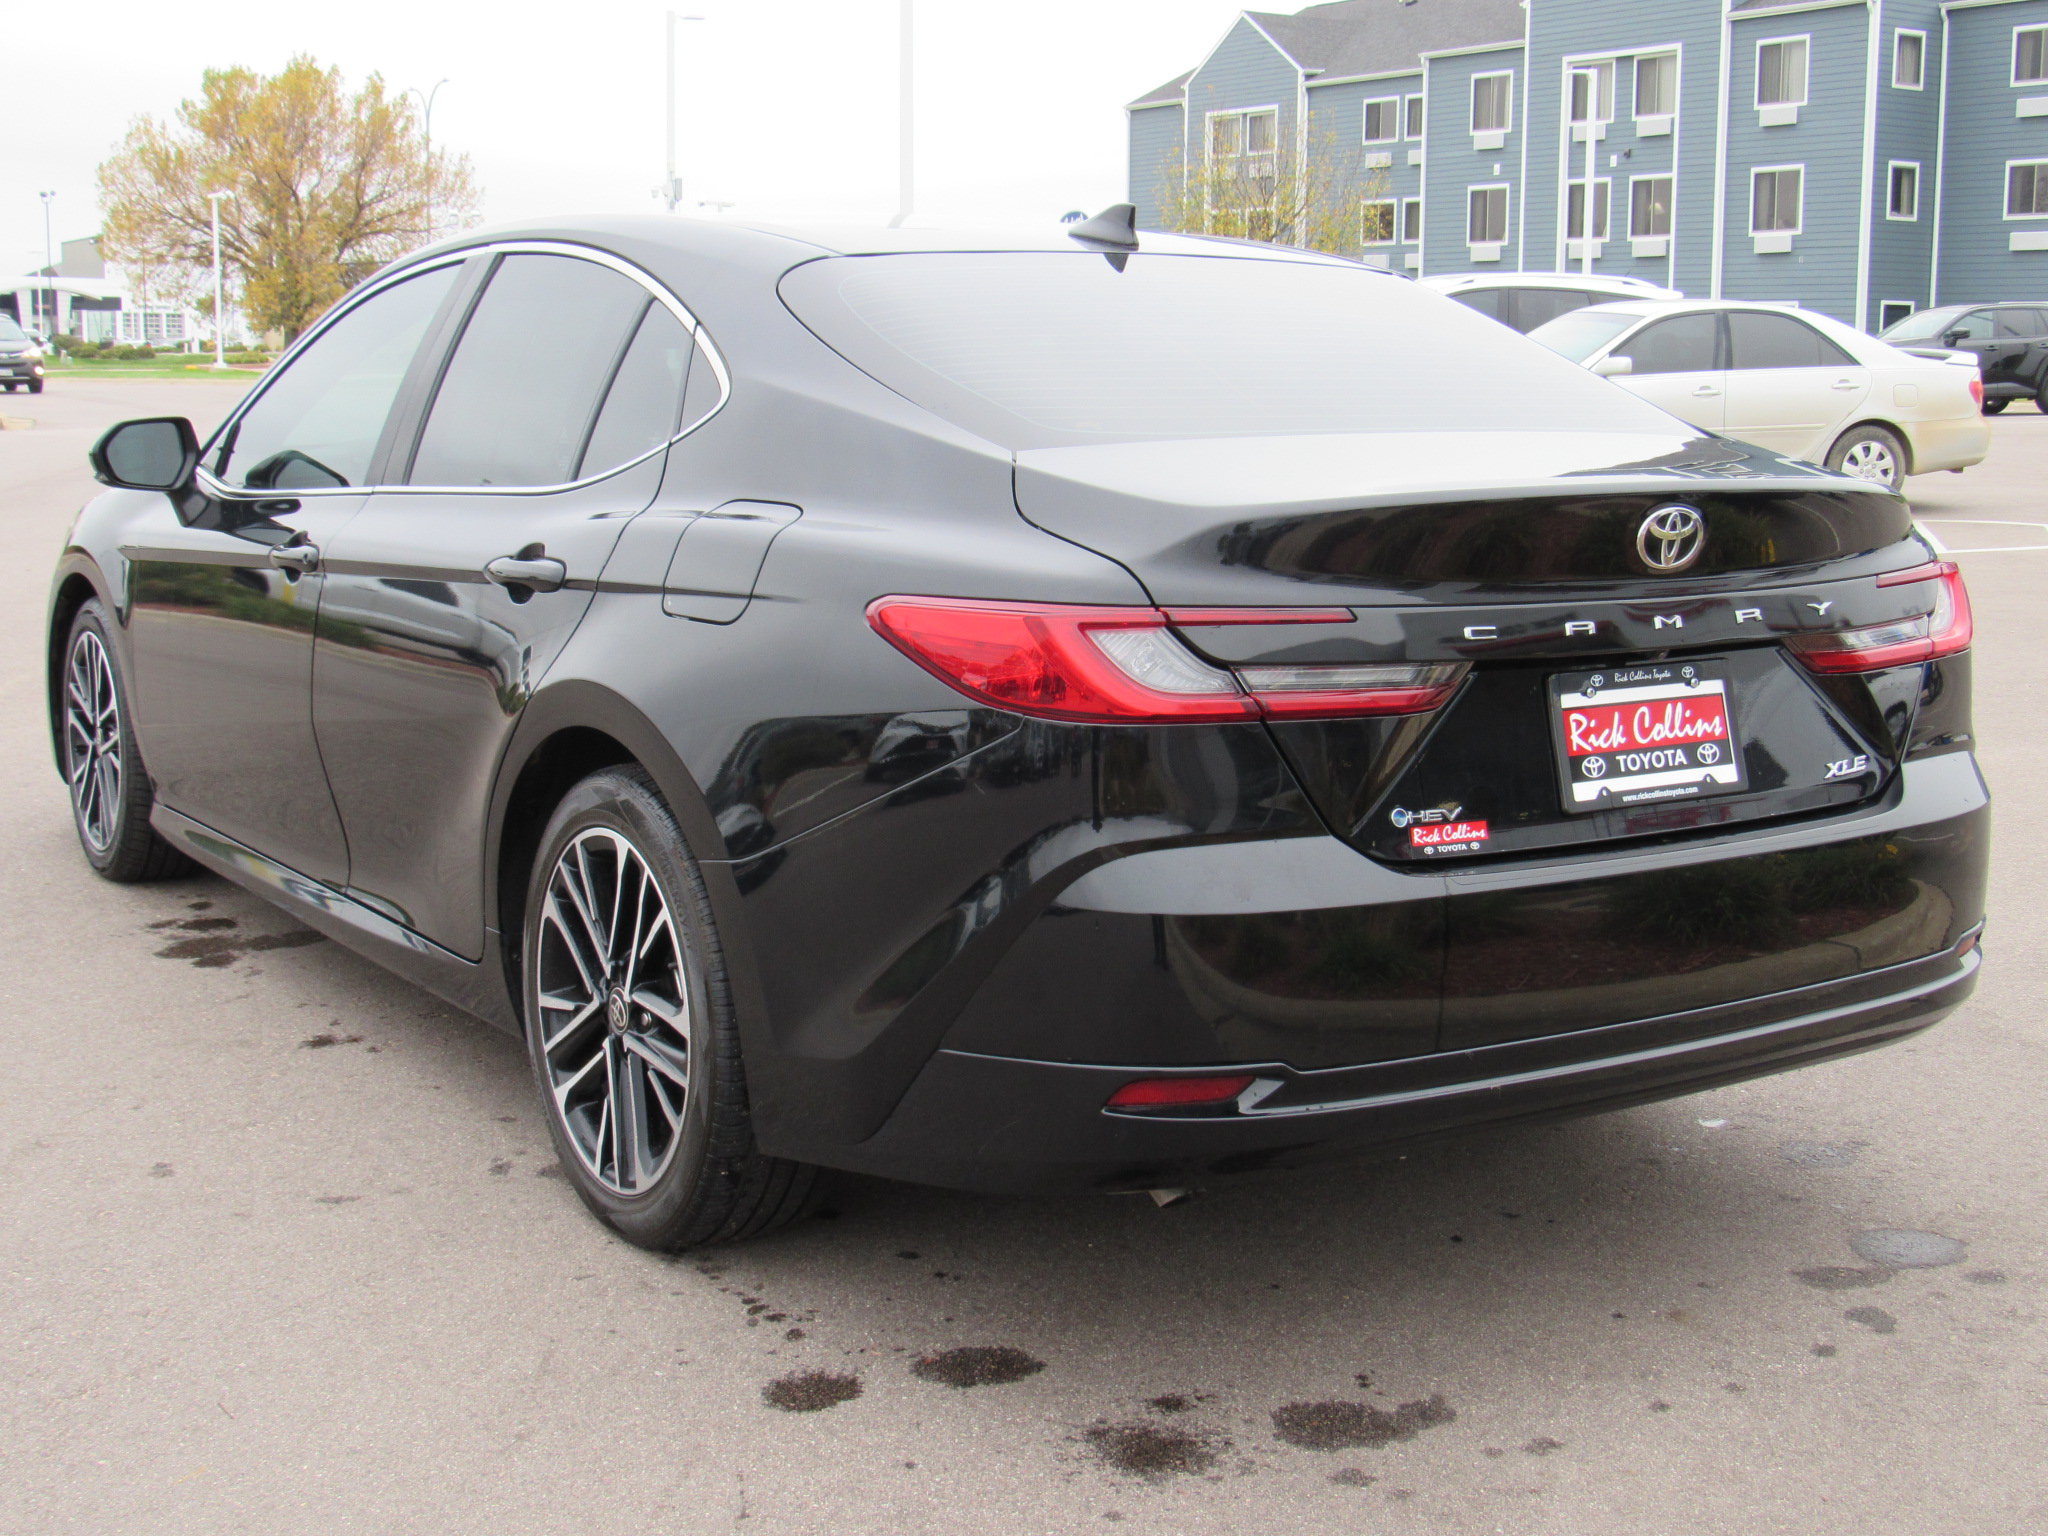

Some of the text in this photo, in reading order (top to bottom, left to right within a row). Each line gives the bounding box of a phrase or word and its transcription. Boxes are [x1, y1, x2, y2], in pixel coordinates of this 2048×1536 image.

[1463, 601, 1832, 640] CAMRY
[1614, 668, 1672, 683] Rick Collins Toyota
[1569, 702, 1723, 752] Rick Collins
[1615, 748, 1688, 773] TOYOTA
[1823, 754, 1868, 779] XLE
[1622, 786, 1699, 803] www.rickcollinstoyota.com
[1413, 823, 1485, 844] Rick Collins
[1436, 843, 1468, 853] TOYOTA
